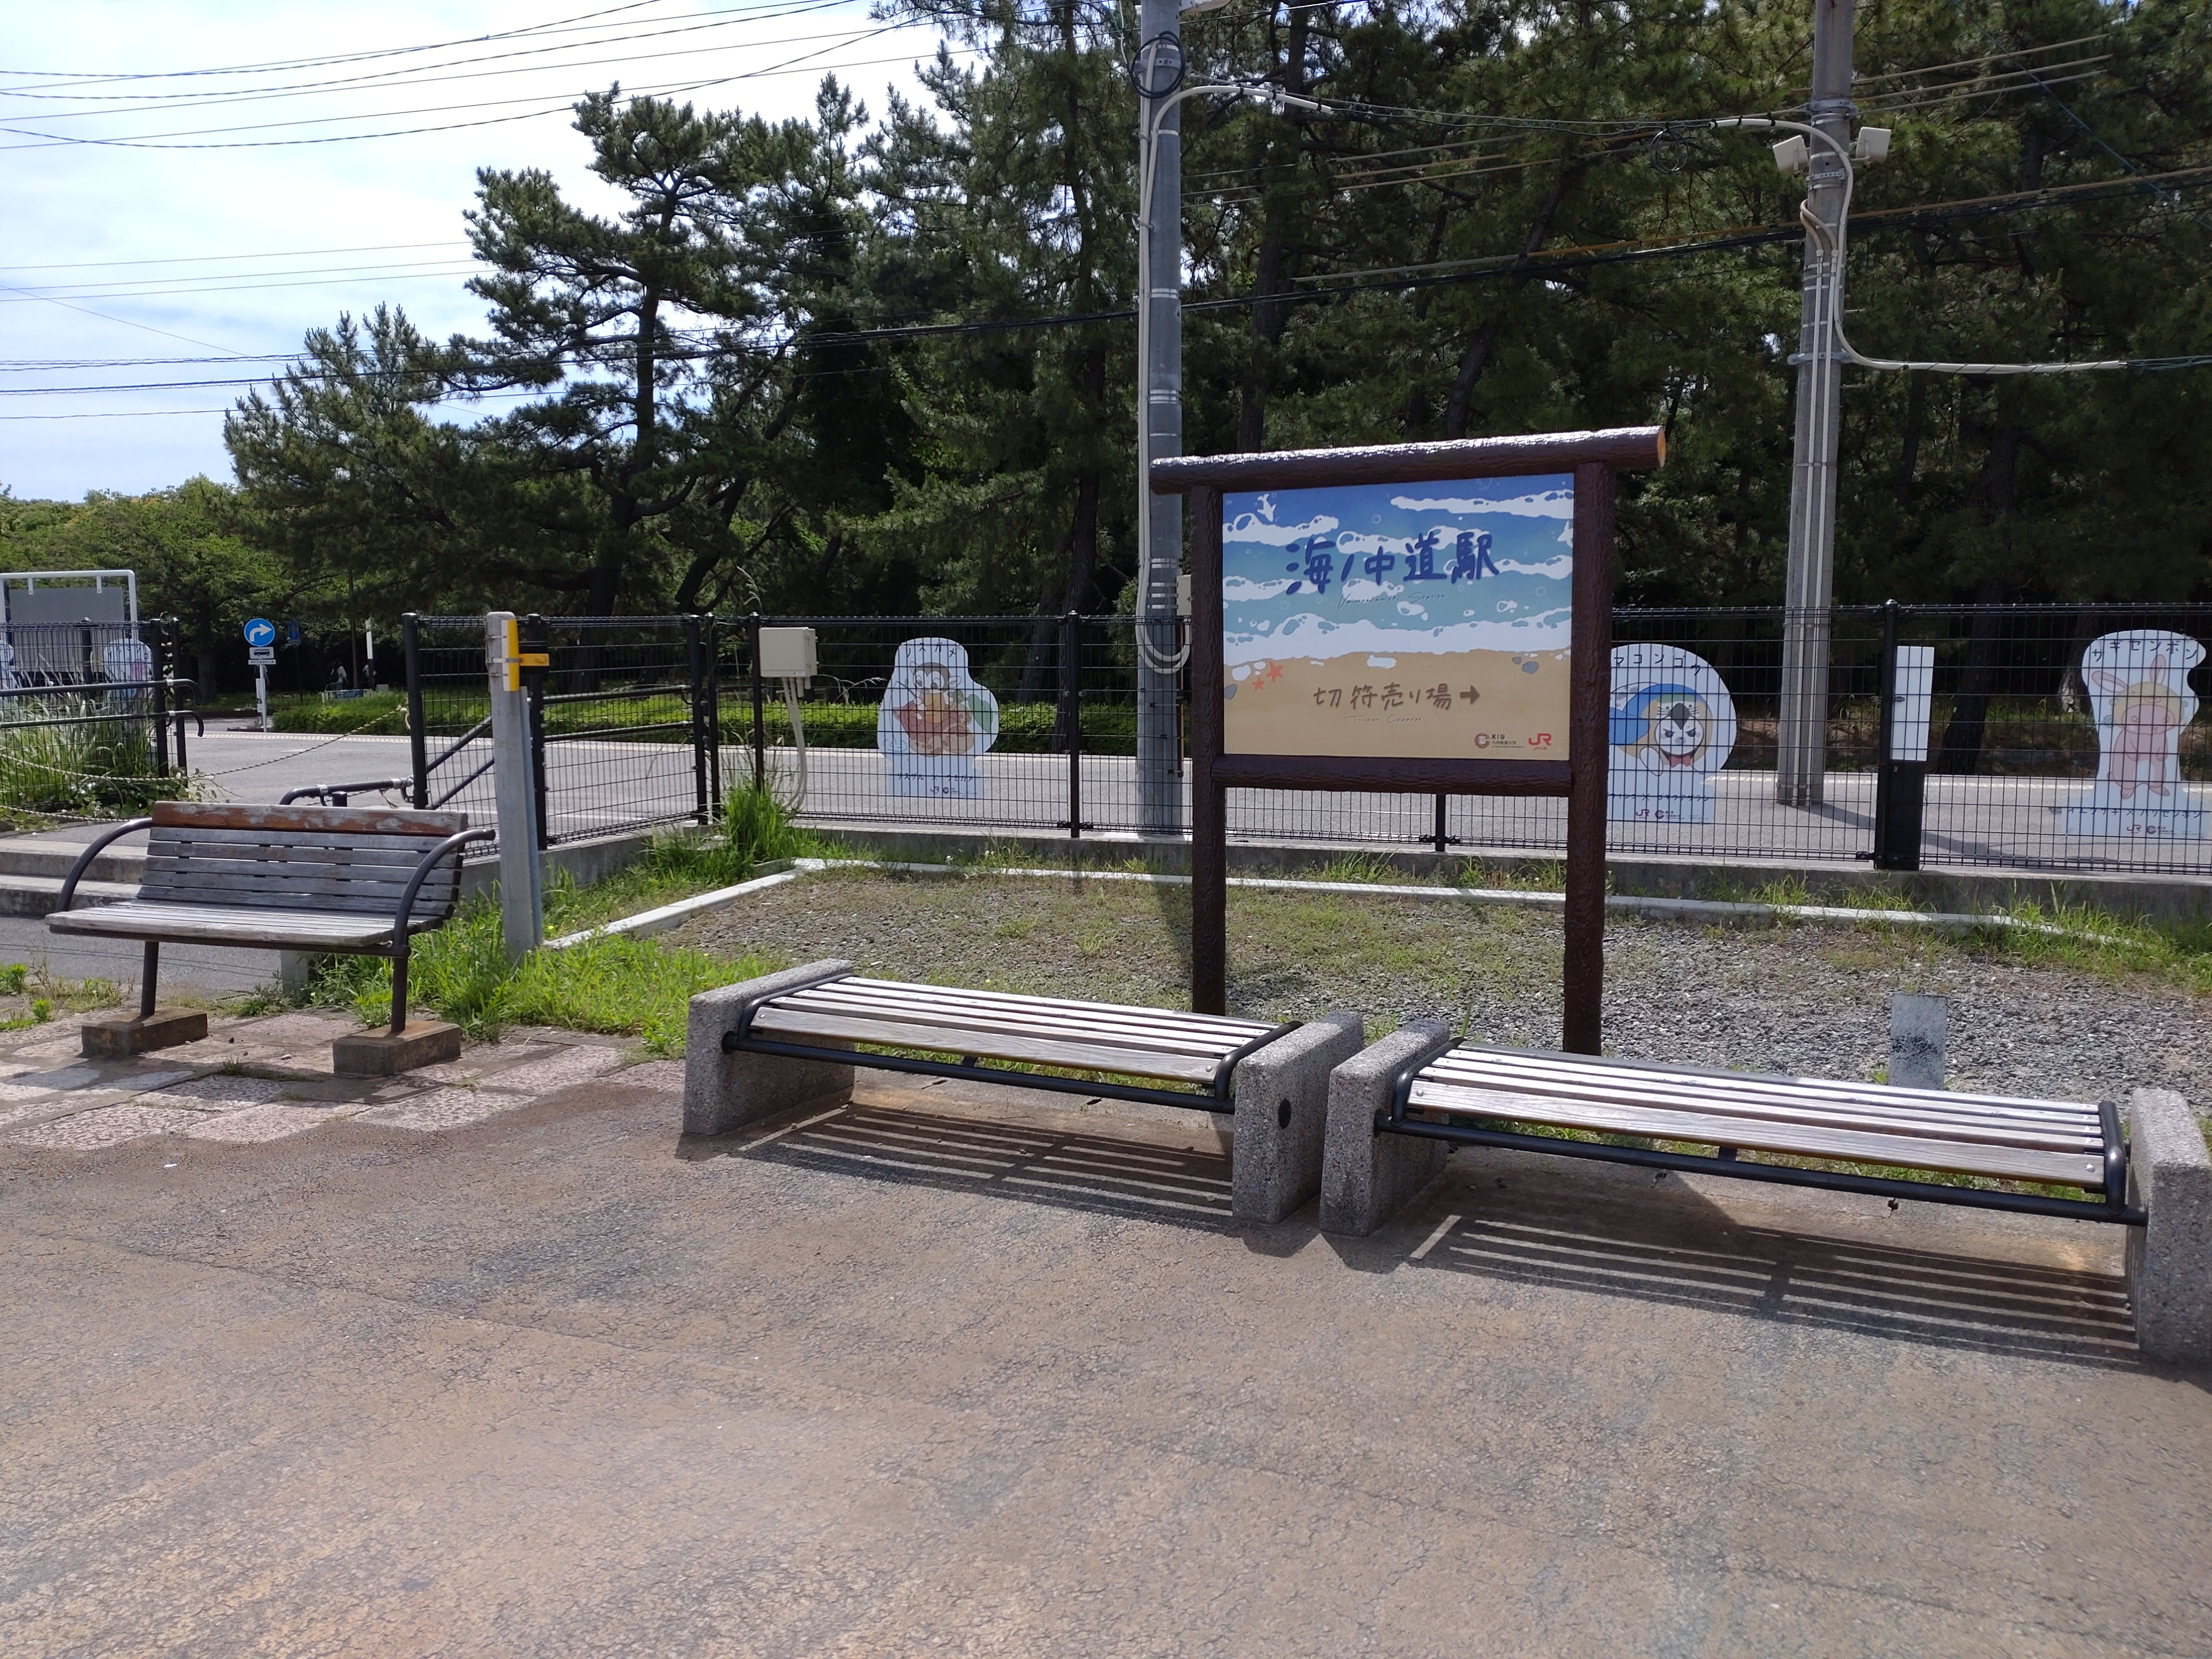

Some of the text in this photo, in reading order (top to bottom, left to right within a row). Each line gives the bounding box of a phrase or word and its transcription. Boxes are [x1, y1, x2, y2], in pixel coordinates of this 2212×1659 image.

[1286, 531, 1499, 594] 海ノ中道駅
[1409, 592, 1446, 604] Station
[2092, 638, 2198, 662] サギセンボン
[1313, 682, 1452, 711] 切符売り場
[1345, 714, 1423, 724] Ticket Counter
[1528, 733, 1552, 746] JR
